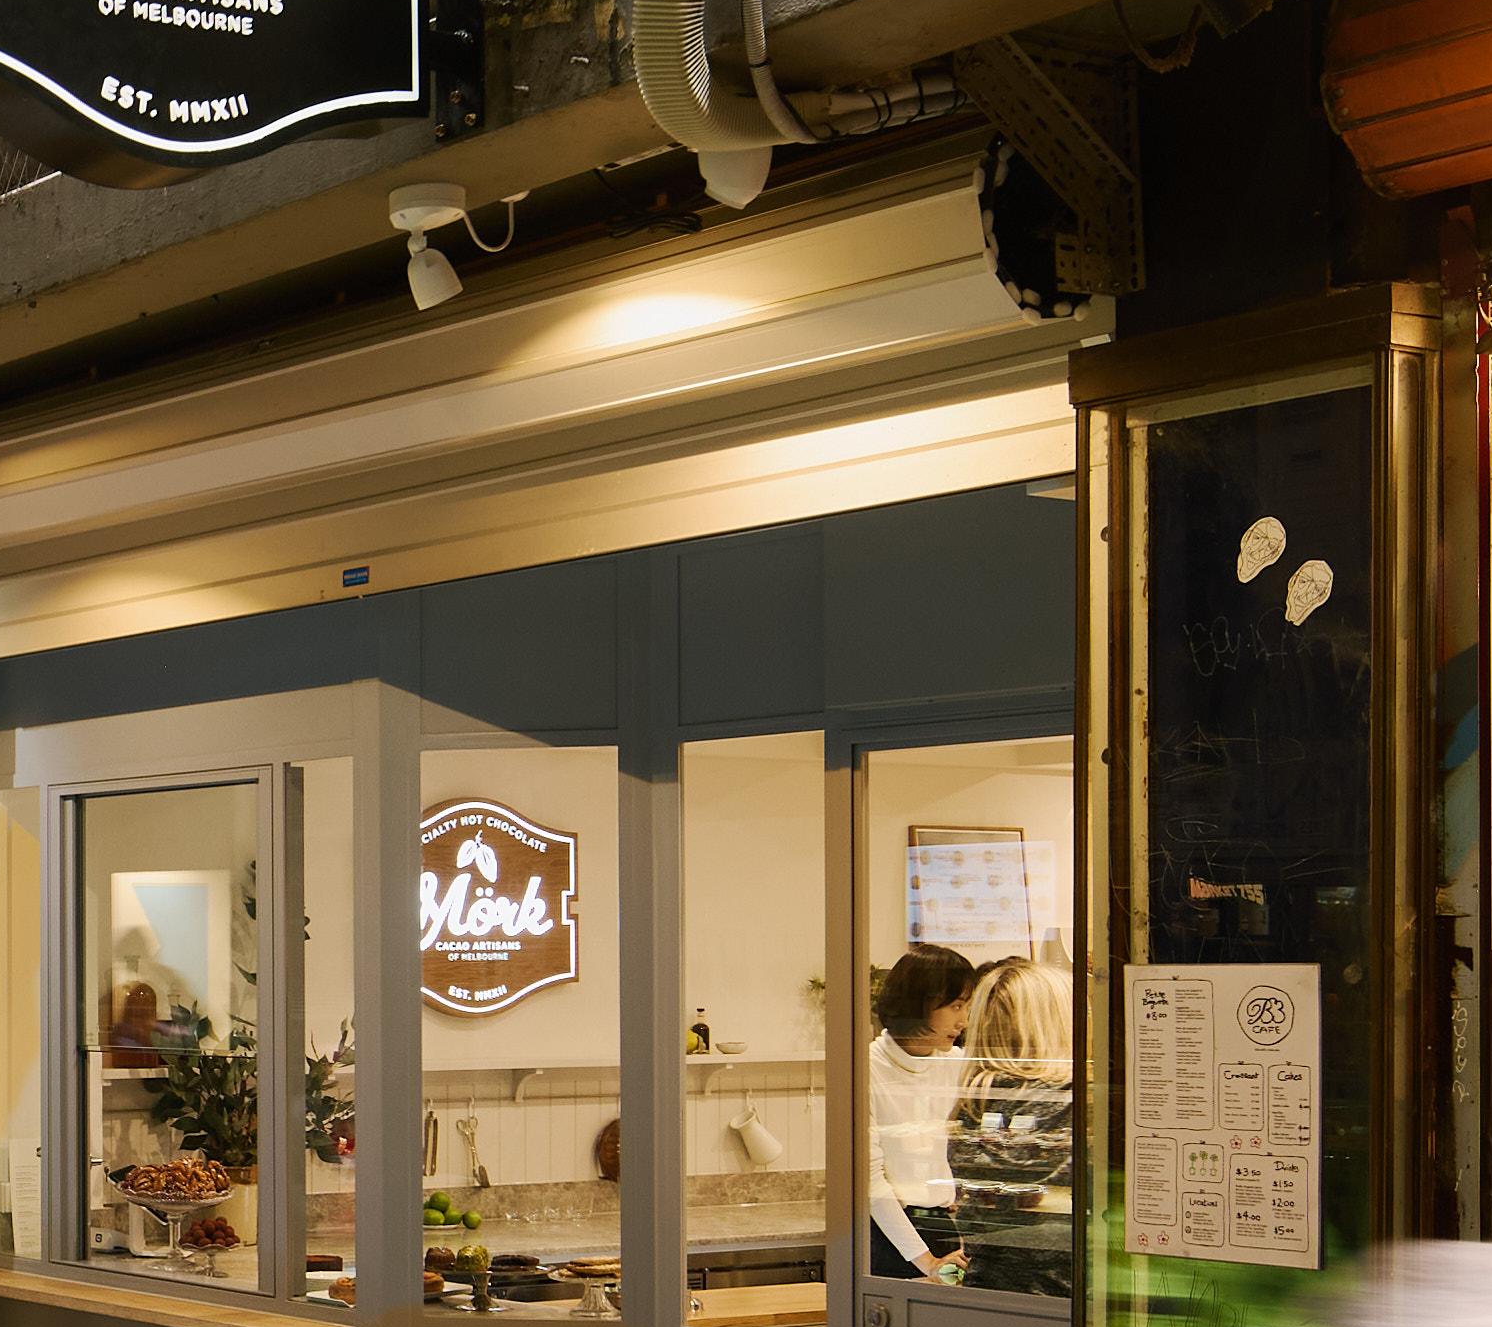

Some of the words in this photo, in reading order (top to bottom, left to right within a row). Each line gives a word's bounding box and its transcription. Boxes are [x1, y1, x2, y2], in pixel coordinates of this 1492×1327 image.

[133, 1, 253, 36] MELBOURNE
[100, 75, 158, 119] EST.
[169, 93, 249, 124] MMXII
[421, 819, 457, 844] CIALTY
[460, 815, 483, 825] HOT
[486, 817, 548, 852] CHOCOLATE
[436, 941, 470, 950] CACAO
[472, 941, 521, 950] ARTISANS
[448, 985, 471, 1000] EST.
[474, 985, 508, 1001] MMXII
[1253, 1025, 1280, 1034] CAFE
